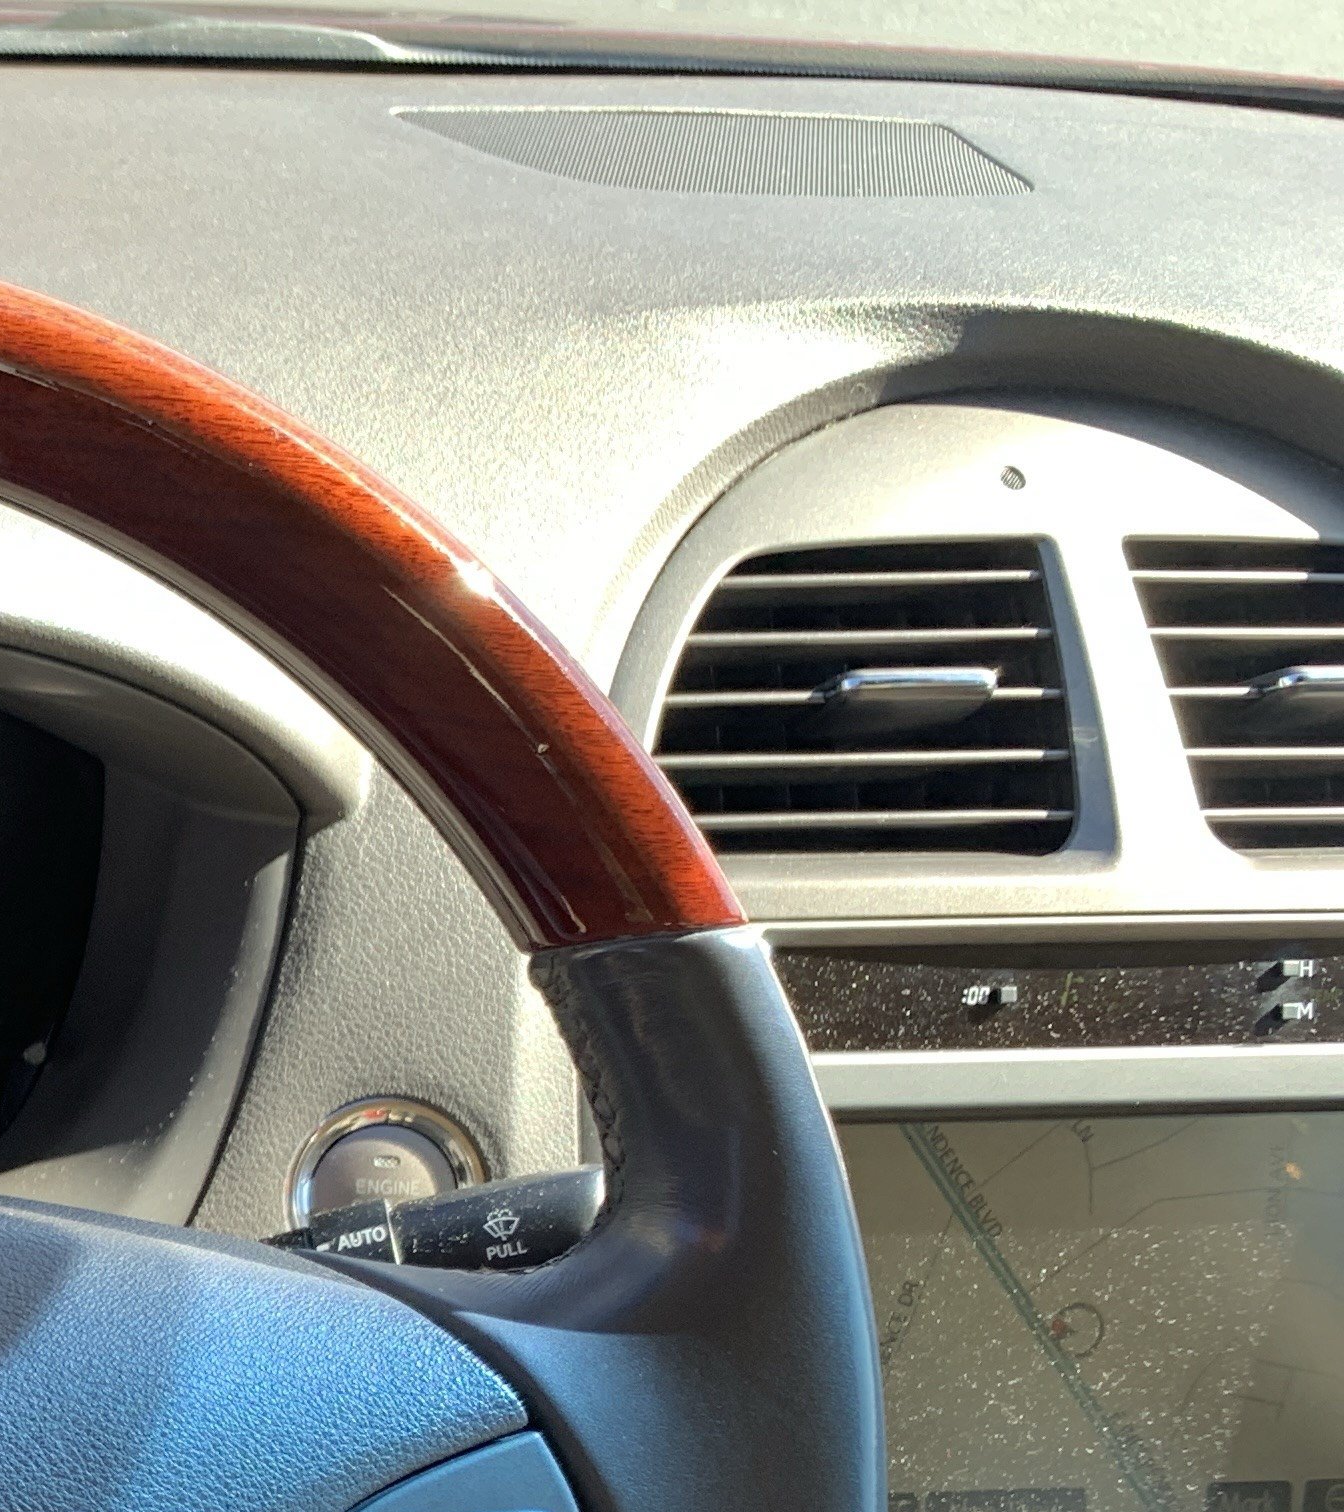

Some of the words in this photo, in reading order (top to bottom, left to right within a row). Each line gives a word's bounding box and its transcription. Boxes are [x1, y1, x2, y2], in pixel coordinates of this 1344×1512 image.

[1300, 959, 1313, 978] H
[1296, 1001, 1313, 1020] M
[928, 1123, 977, 1198] NDENCE
[967, 1193, 1004, 1241] BLVD
[337, 1223, 386, 1251] AUTO
[486, 1243, 528, 1261] PULL
